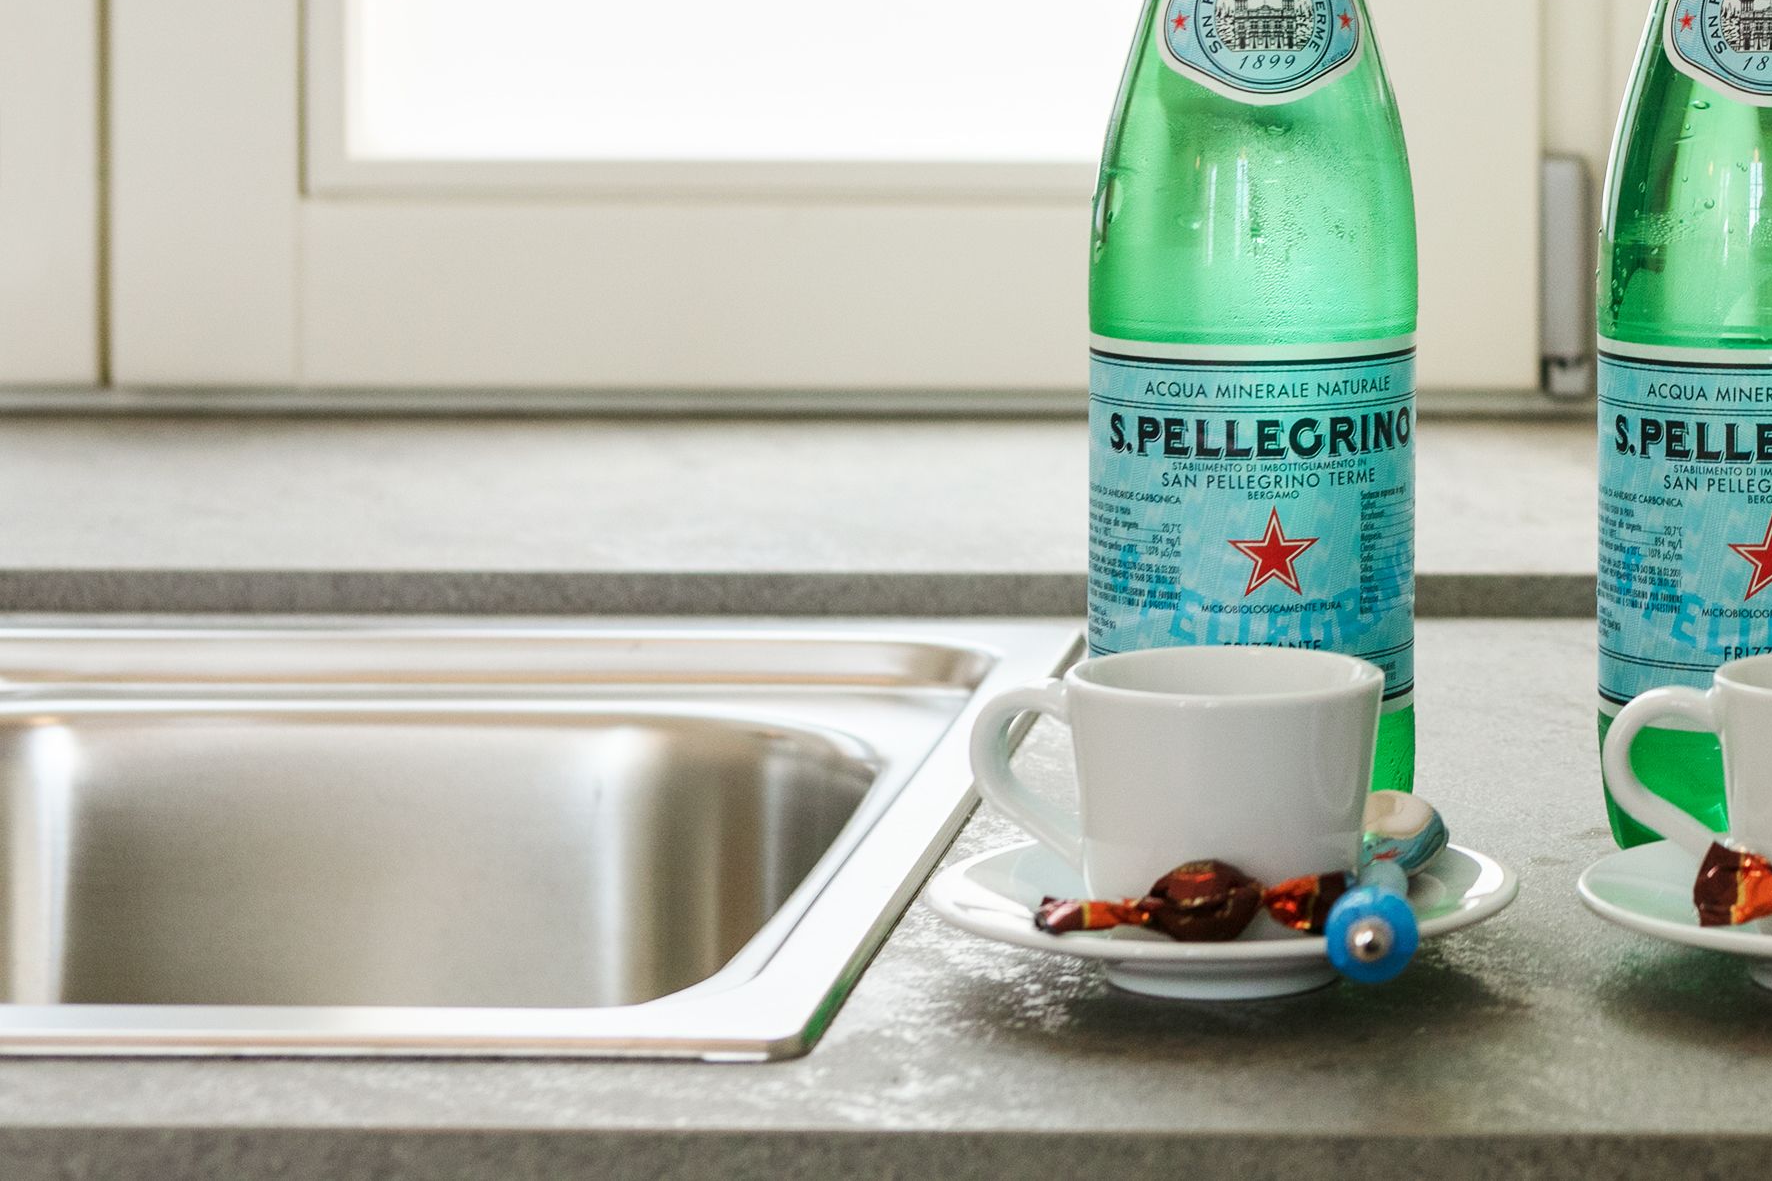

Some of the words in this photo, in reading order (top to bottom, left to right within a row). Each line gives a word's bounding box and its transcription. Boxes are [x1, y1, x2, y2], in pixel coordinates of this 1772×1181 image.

[1202, 14, 1223, 54] SAN
[1708, 15, 1728, 55] SAN
[1239, 54, 1296, 70] 1899
[1144, 380, 1208, 399] ACQUA
[1215, 382, 1309, 399] MINERALE
[1317, 375, 1390, 398] NATURALE
[1647, 382, 1708, 401] ACQUA
[1109, 406, 1411, 461] S.PELLEGRINO
[1172, 461, 1241, 473] STABILIMENTO
[1246, 464, 1257, 473] DI
[1260, 459, 1355, 473] IMBOTTIGLIAMENTO
[1357, 458, 1368, 467] IN
[1673, 464, 1743, 476] STABILIMENTO
[1747, 467, 1757, 476] DI
[1161, 472, 1197, 488] SAN
[1207, 474, 1320, 490] PELLEGRINO
[1329, 468, 1375, 486] TERME
[1663, 474, 1698, 491] SAN
[1247, 490, 1300, 501] BERGAMO
[1201, 602, 1317, 615] MICROBIOLOGICAMENTE
[1319, 601, 1342, 611] PURA
